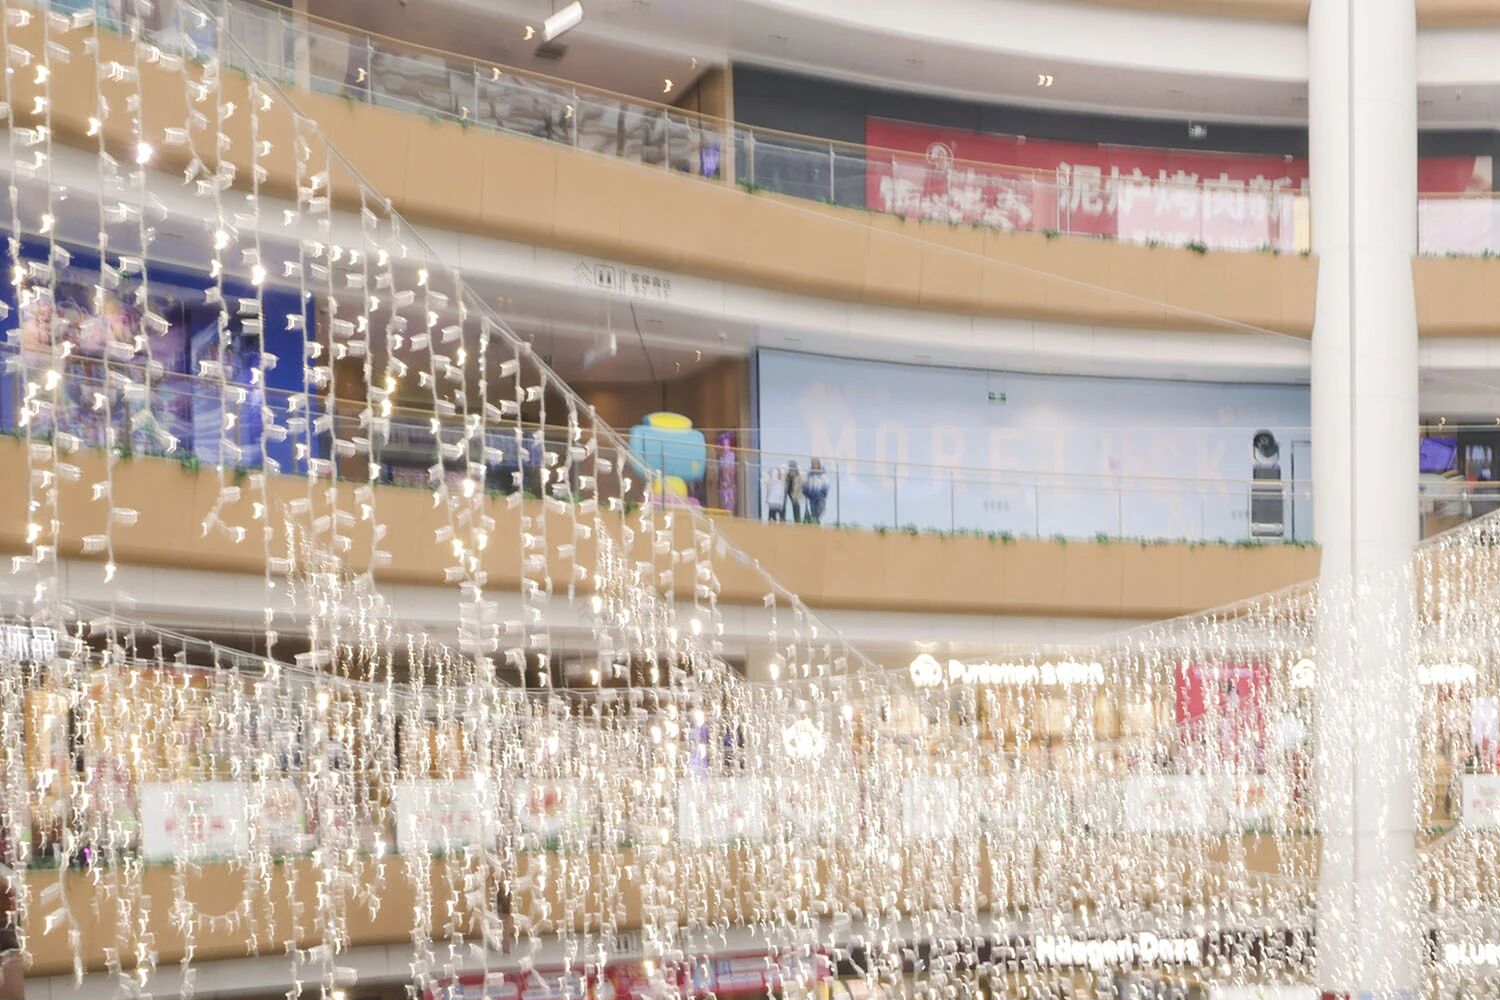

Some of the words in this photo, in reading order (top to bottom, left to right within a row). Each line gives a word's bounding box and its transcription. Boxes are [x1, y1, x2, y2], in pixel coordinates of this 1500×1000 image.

[1059, 161, 1310, 224] 泥炉烤肉新
